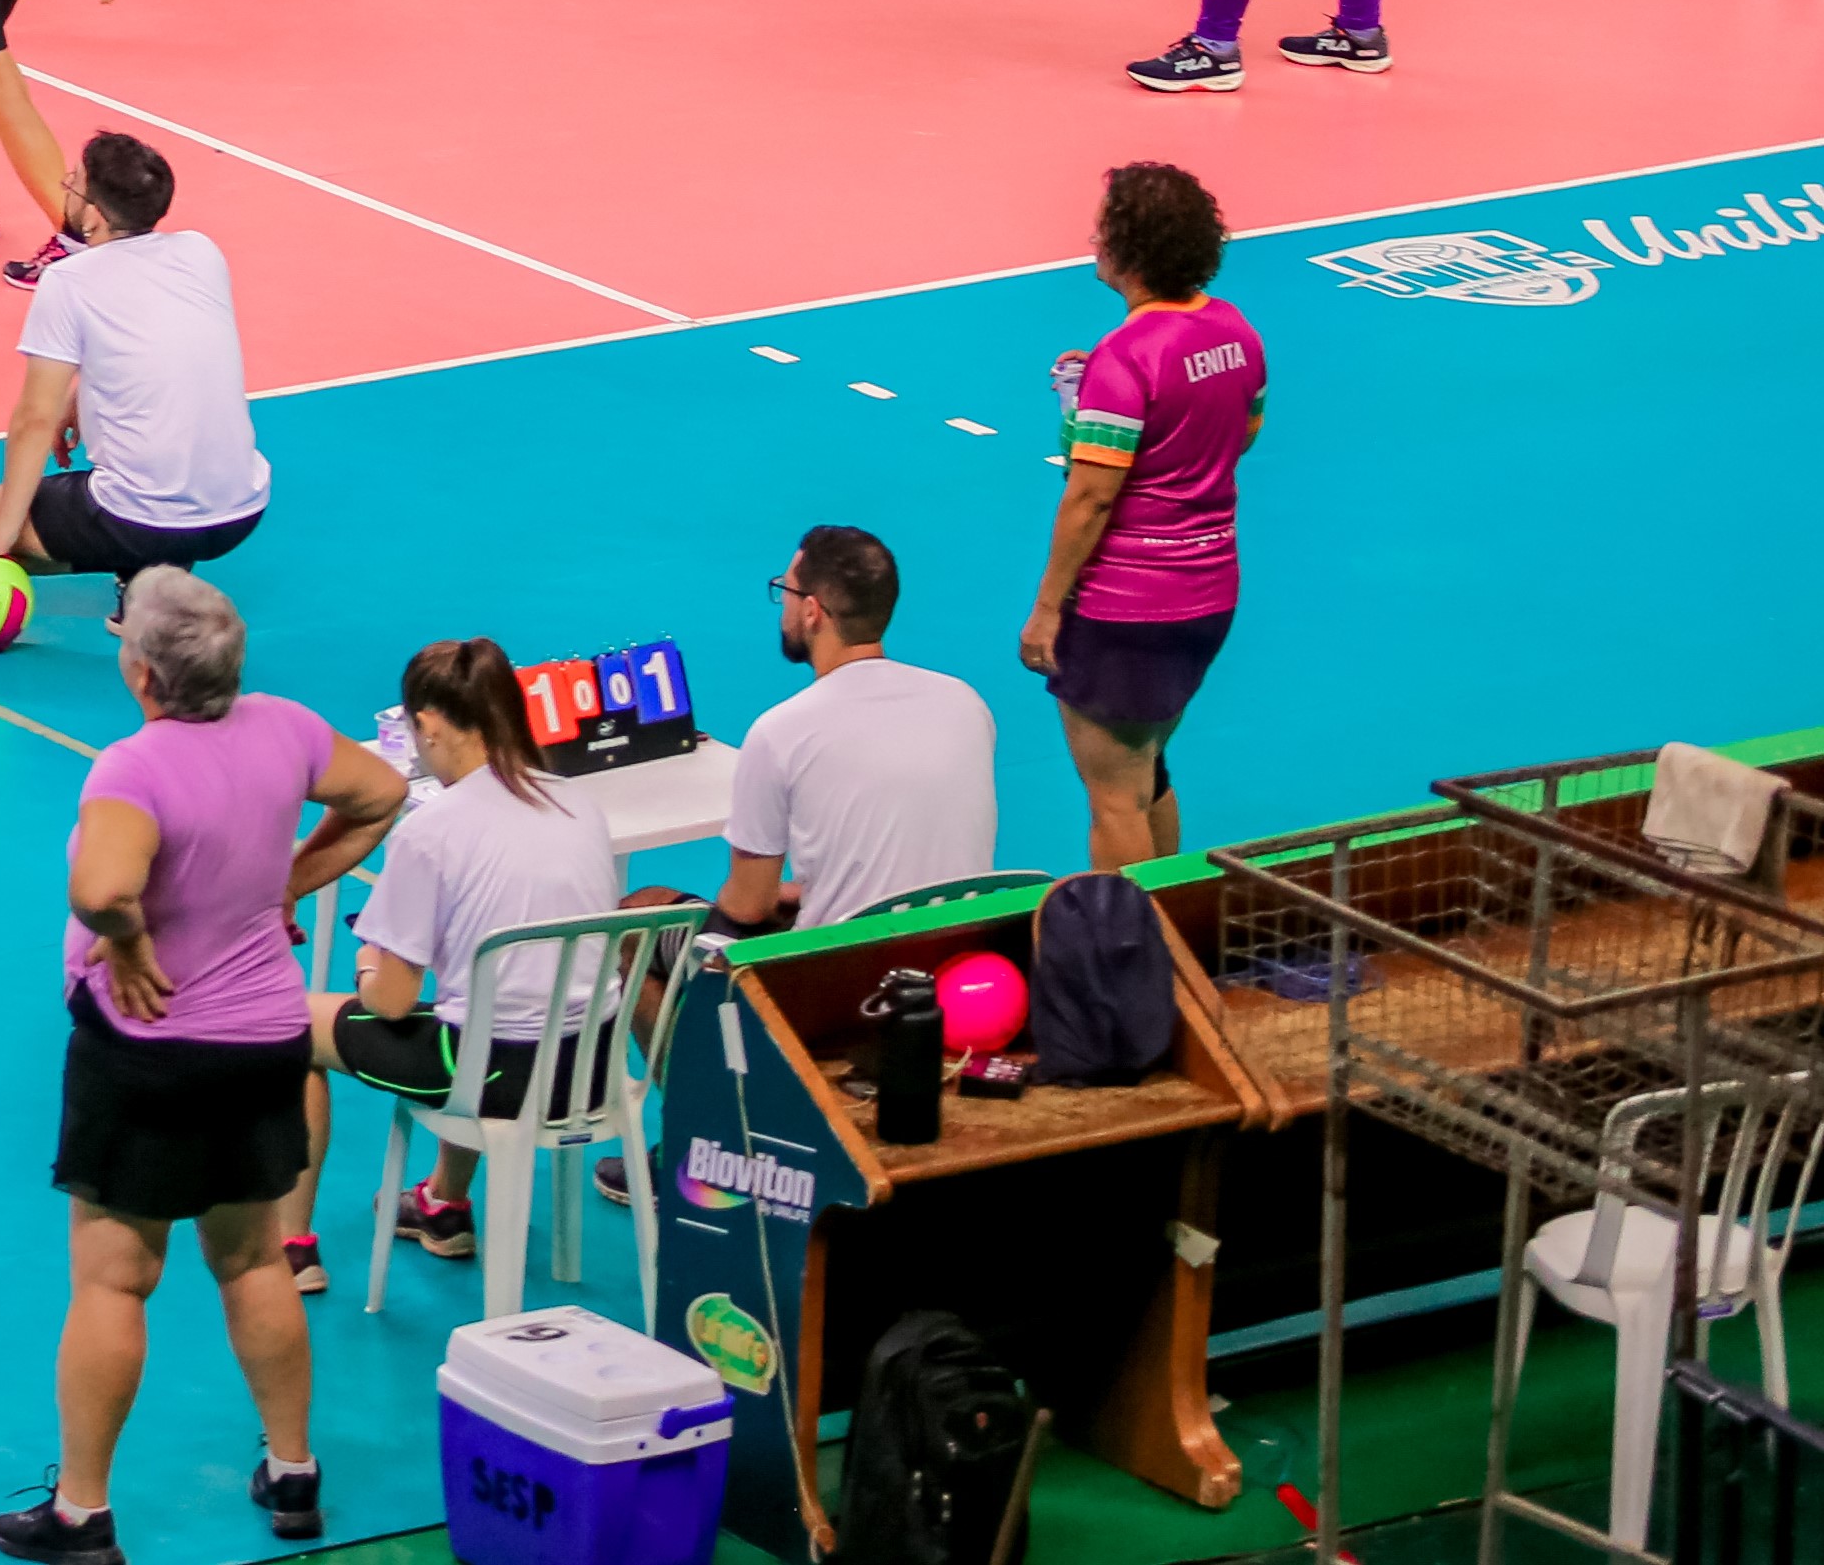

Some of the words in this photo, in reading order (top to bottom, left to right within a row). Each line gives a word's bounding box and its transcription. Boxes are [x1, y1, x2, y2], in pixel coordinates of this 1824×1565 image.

[1174, 54, 1213, 74] FILA
[1315, 38, 1351, 53] FILA
[1581, 182, 1824, 266] Unili
[1183, 341, 1248, 383] LENITA
[527, 672, 562, 734] 1
[573, 679, 595, 711] 0
[608, 671, 633, 705] 0
[641, 650, 676, 712] 1
[687, 1136, 816, 1209] Bioviton
